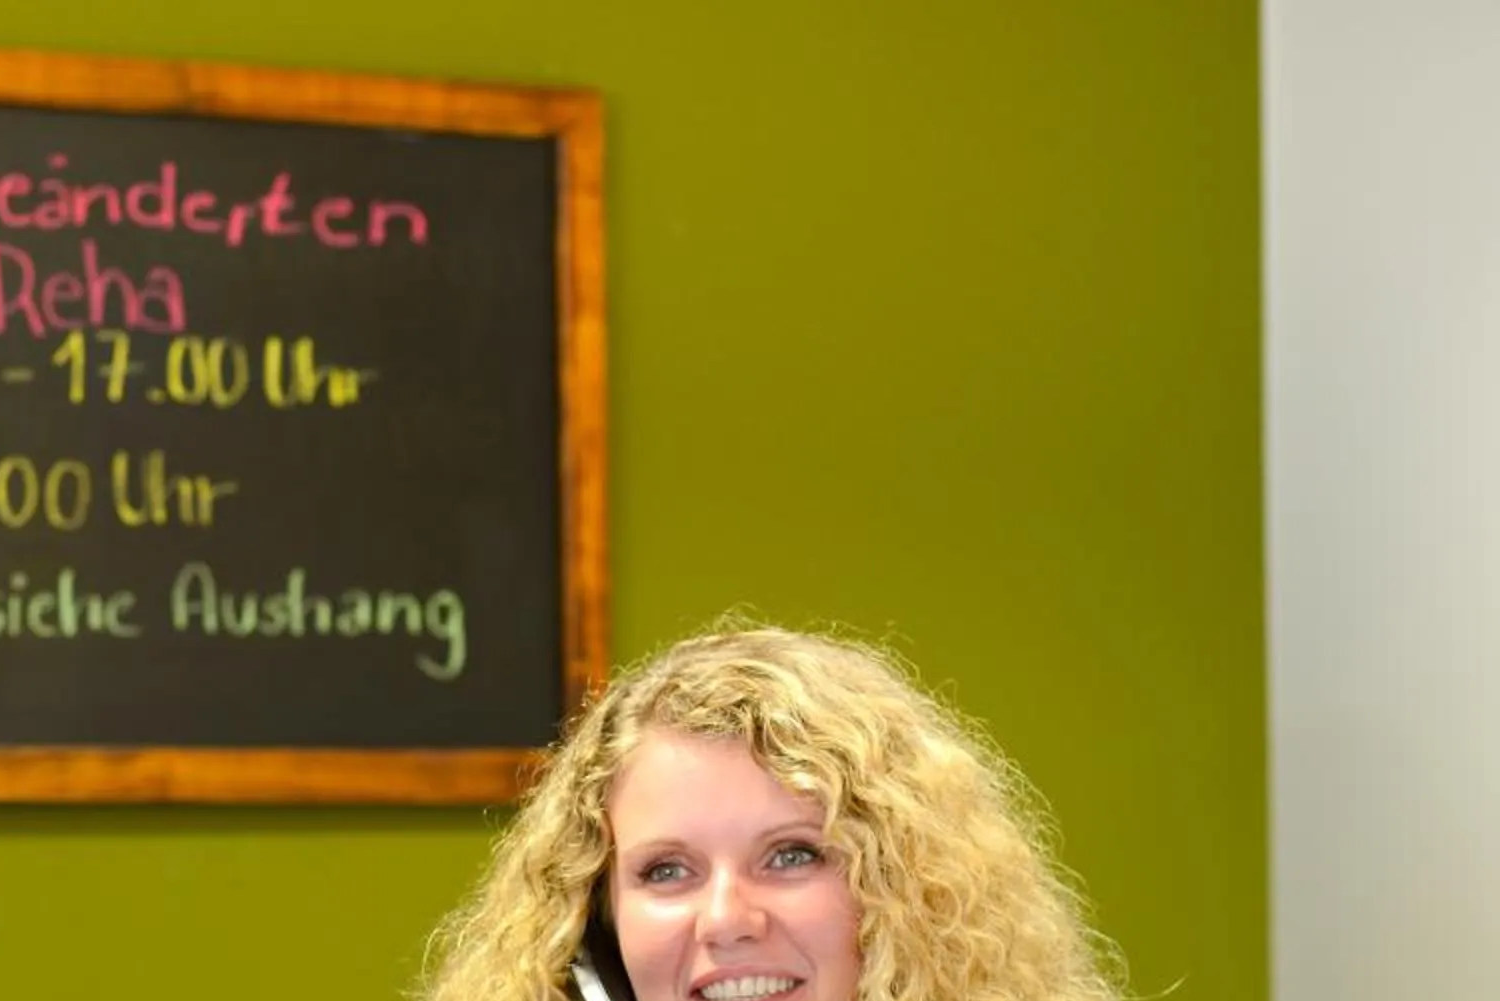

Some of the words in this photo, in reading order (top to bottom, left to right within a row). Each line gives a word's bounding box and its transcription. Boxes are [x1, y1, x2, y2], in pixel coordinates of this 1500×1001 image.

[51, 328, 250, 408] 17.00
[262, 335, 376, 408] Uhr
[111, 450, 238, 526] Uhr
[171, 561, 466, 680] Aushang
